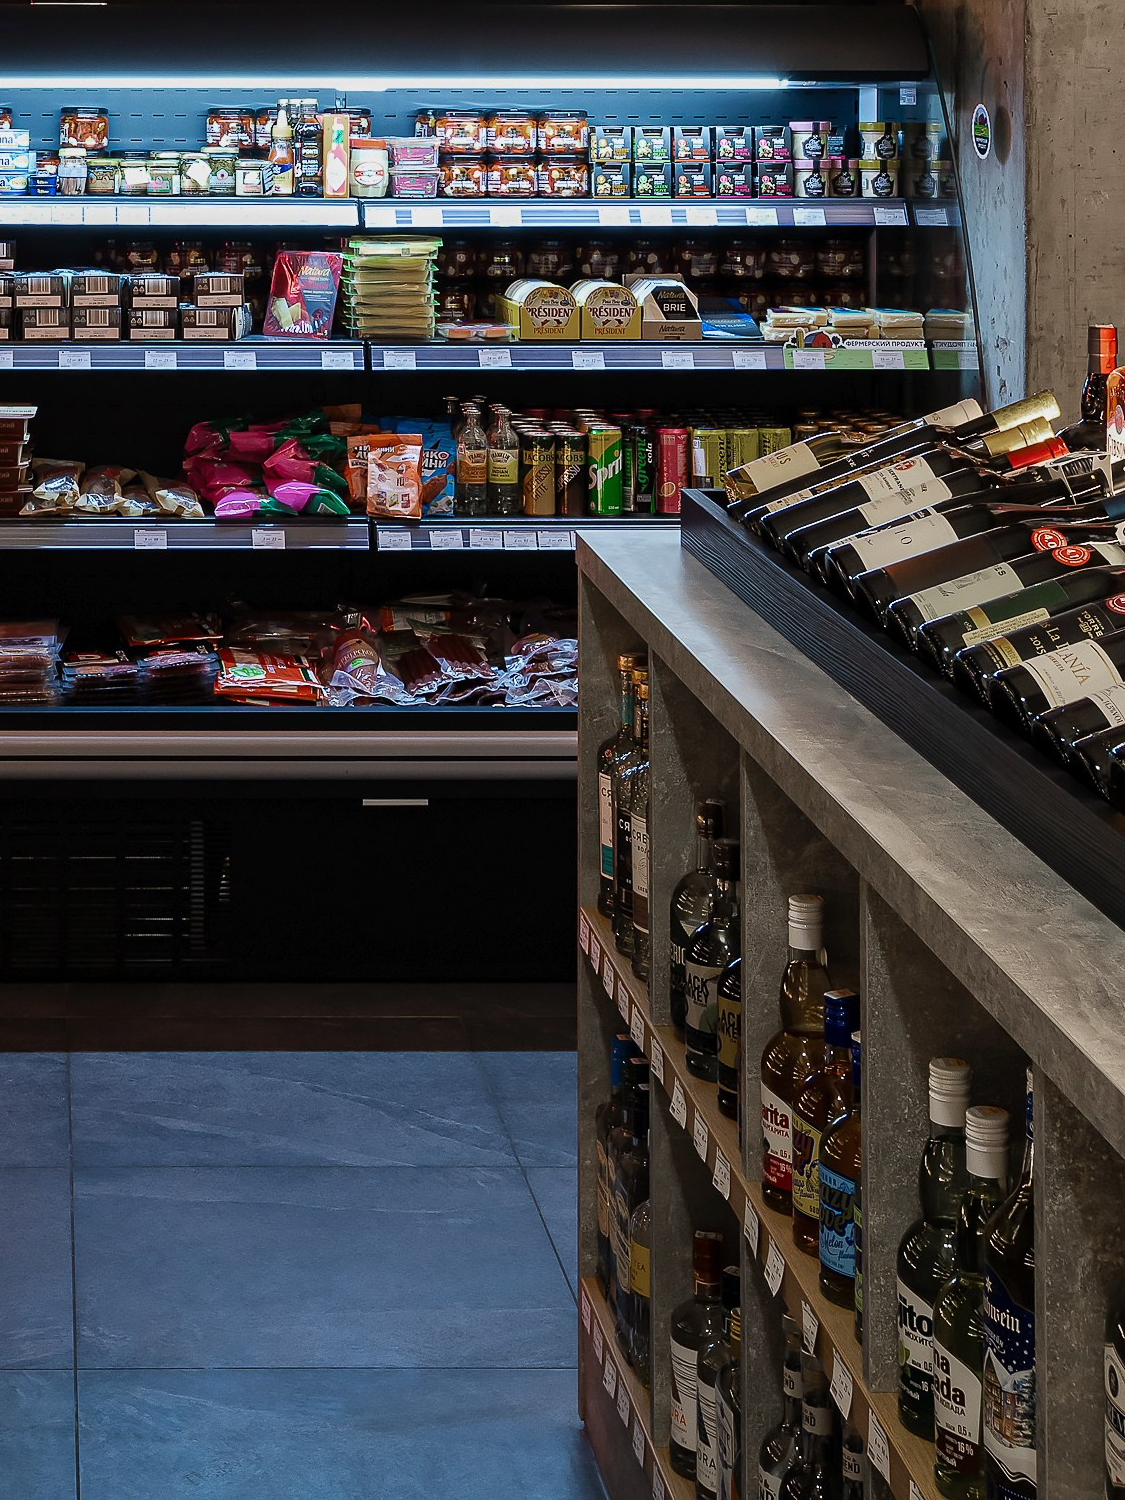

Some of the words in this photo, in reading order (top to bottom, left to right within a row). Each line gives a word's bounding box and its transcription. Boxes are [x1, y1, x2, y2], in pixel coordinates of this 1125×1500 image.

[657, 291, 685, 300] Natura
[527, 306, 574, 318] PRÉSIDENT
[588, 306, 636, 319] PRÉSIDENT
[663, 304, 686, 312] BRIE
[533, 327, 565, 335] PRÉSIDENT
[595, 327, 625, 335] PRÉSIDENT
[659, 325, 685, 333] Natura
[525, 454, 554, 463] JACOBS
[1046, 626, 1061, 642] La
[1029, 636, 1047, 656] 2015
[957, 1424, 967, 1435] 0,5
[957, 1442, 973, 1456] 16%
